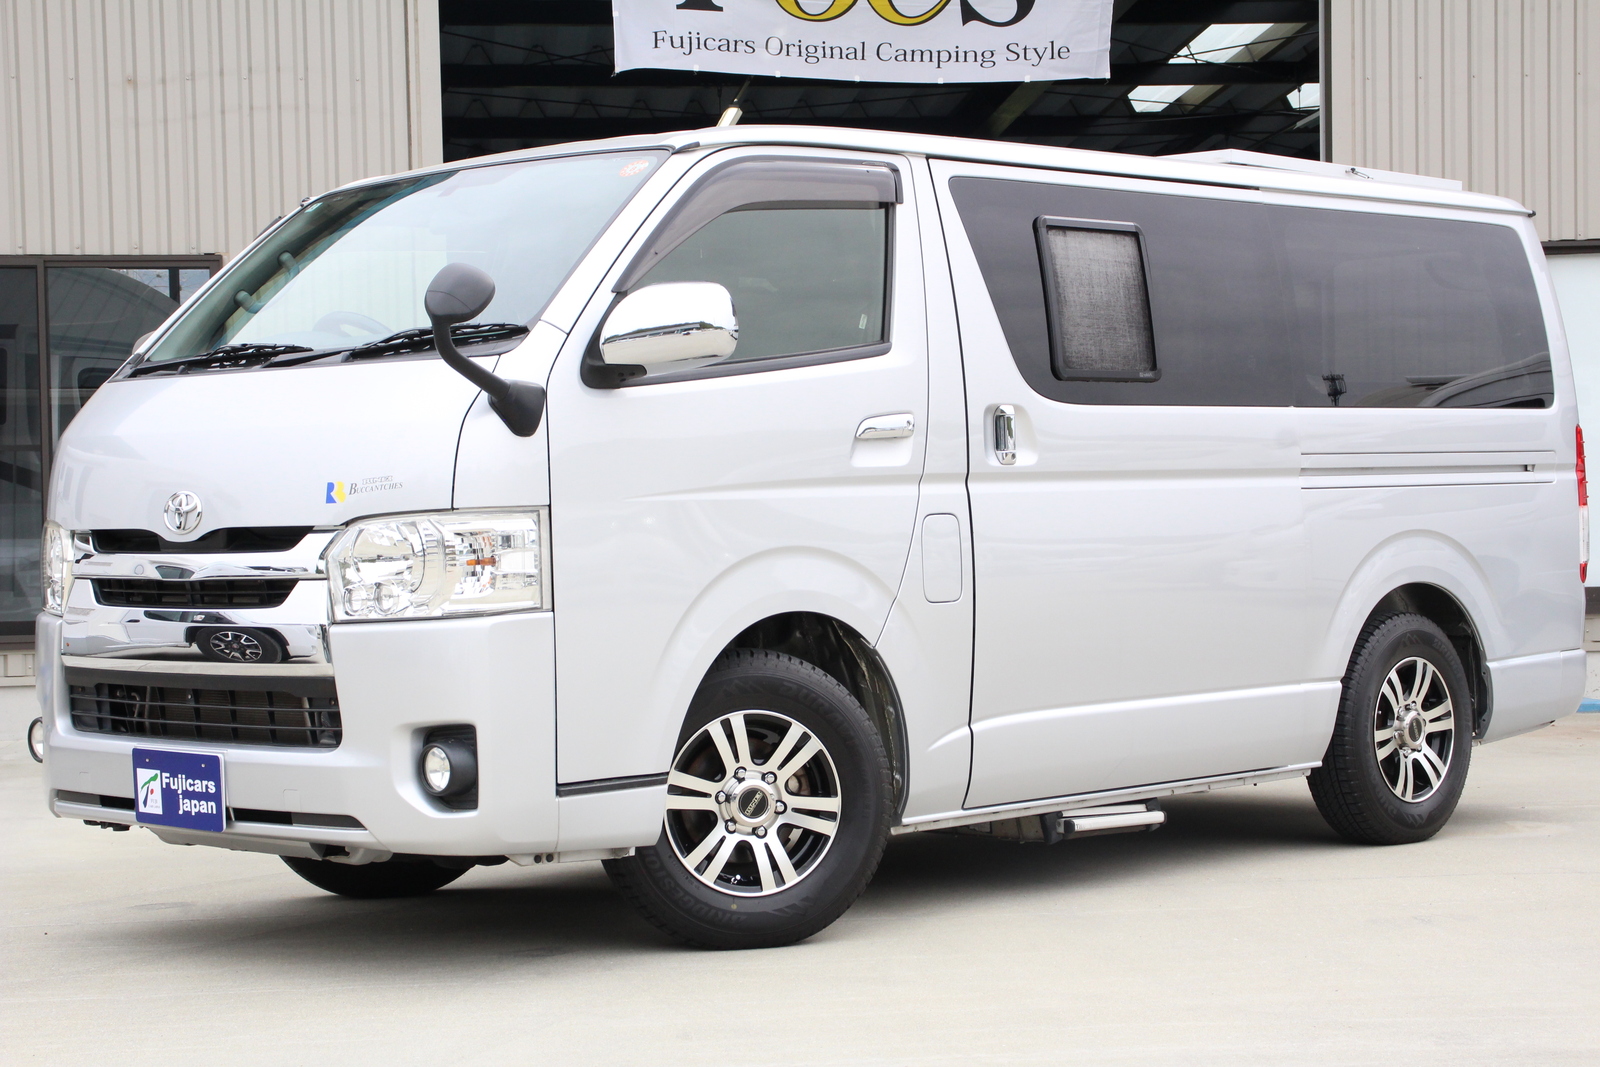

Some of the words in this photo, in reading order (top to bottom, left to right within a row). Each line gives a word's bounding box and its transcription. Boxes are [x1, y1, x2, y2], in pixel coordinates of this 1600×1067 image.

[652, 30, 756, 56] Fujicars
[765, 36, 866, 64] Original
[876, 42, 996, 69] Camping
[1005, 41, 1071, 67] Style
[161, 772, 216, 794] Fujicars
[178, 794, 217, 816] japan
